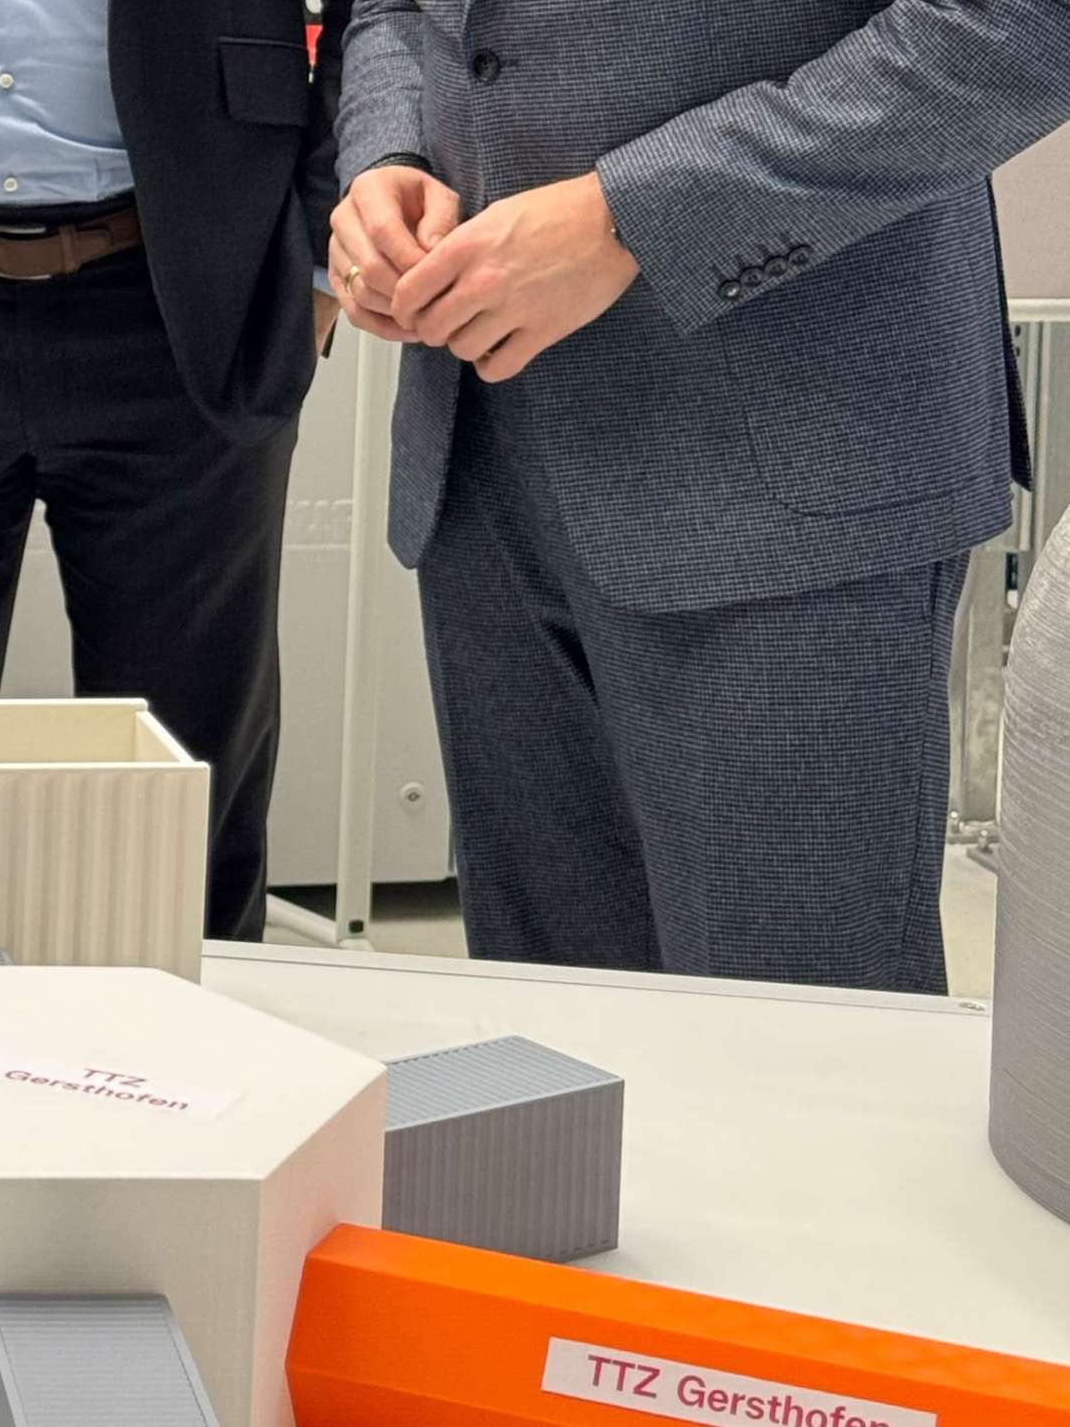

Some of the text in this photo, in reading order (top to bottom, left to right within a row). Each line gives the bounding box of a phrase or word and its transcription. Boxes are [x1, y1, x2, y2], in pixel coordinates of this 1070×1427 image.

[4, 1069, 189, 1111] Gersthofen
[83, 1067, 149, 1088] TTZ
[587, 1354, 889, 1427] TTZ Gersthof
